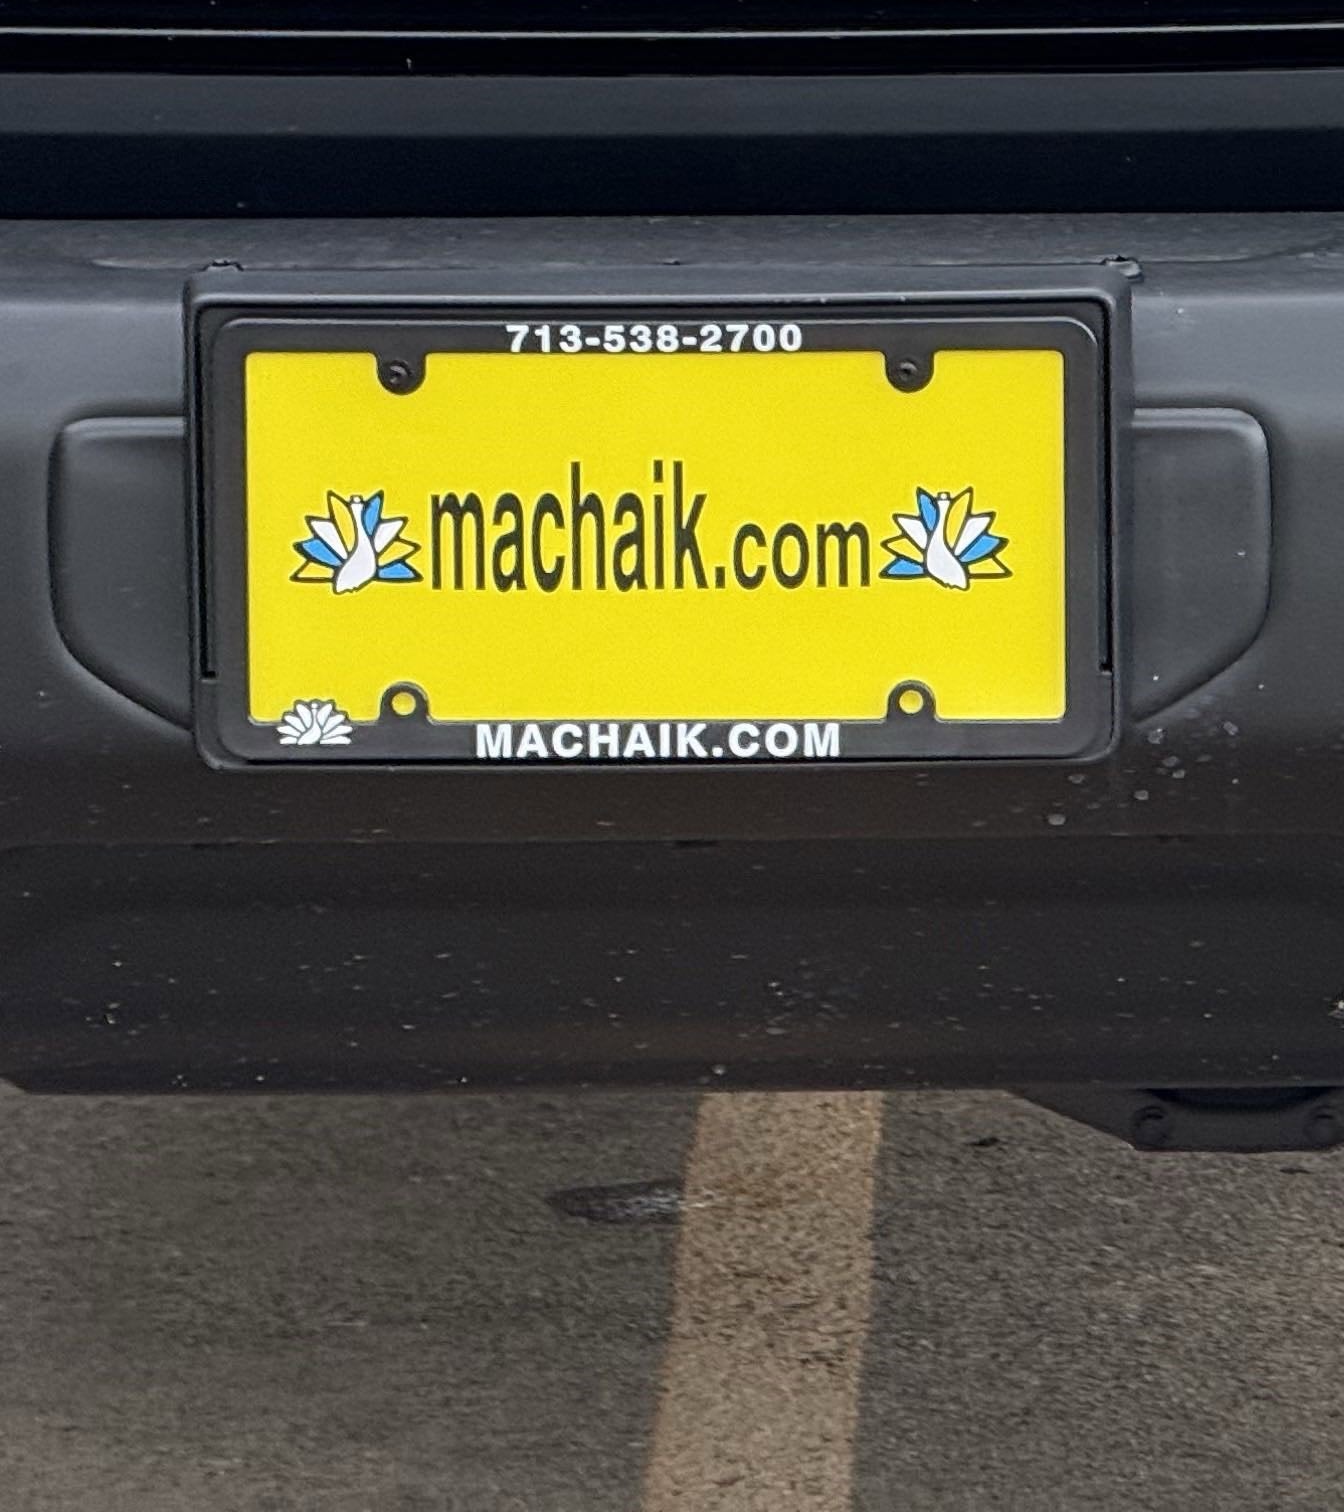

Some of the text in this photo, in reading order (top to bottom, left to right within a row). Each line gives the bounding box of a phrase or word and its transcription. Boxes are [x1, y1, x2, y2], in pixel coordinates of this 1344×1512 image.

[505, 323, 803, 354] 713-538-2700
[430, 460, 870, 592] machaik.com
[474, 723, 842, 759] MACHAIK.COM
